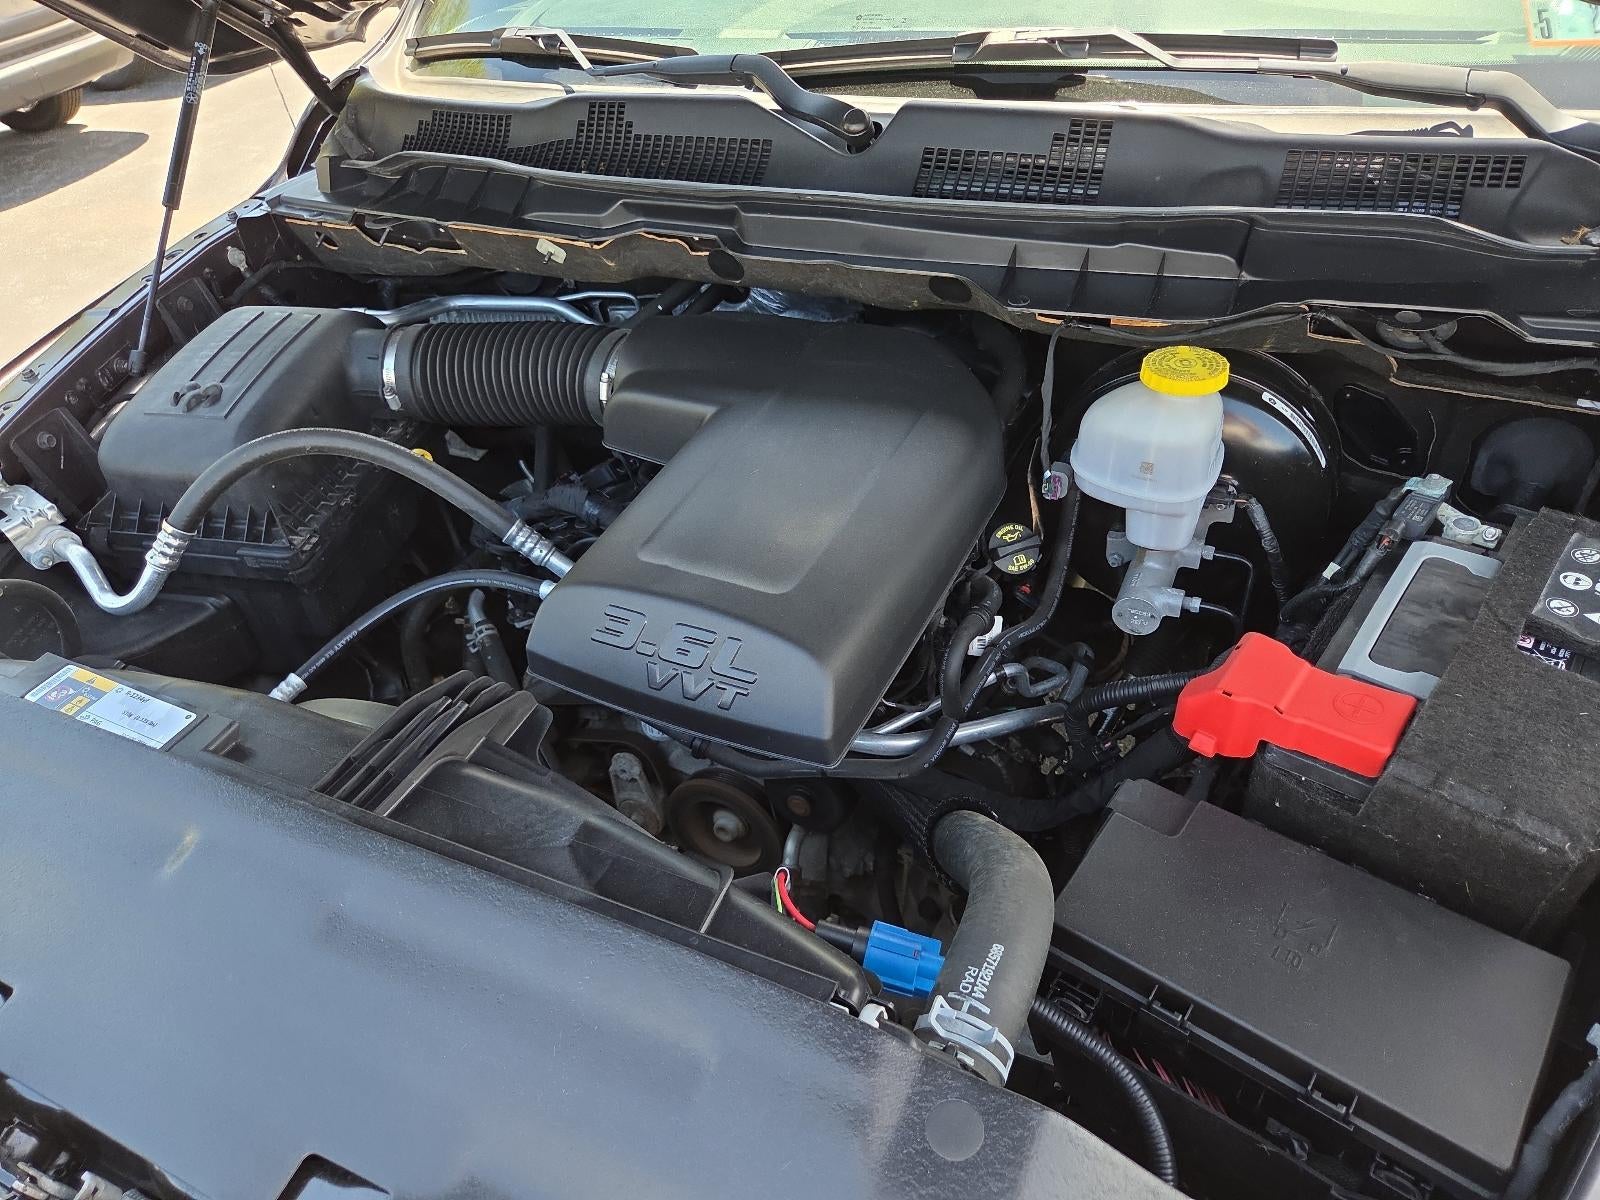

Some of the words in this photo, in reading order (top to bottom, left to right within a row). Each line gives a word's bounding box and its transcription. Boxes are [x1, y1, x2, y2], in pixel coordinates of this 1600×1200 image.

[1536, 8, 1553, 39] 5
[996, 525, 1014, 538] ENGINE
[1014, 524, 1024, 532] OIL
[590, 604, 758, 684] 3.6L
[646, 660, 751, 711] VVT
[931, 739, 947, 763] VACUUM
[959, 965, 979, 994] RAD
